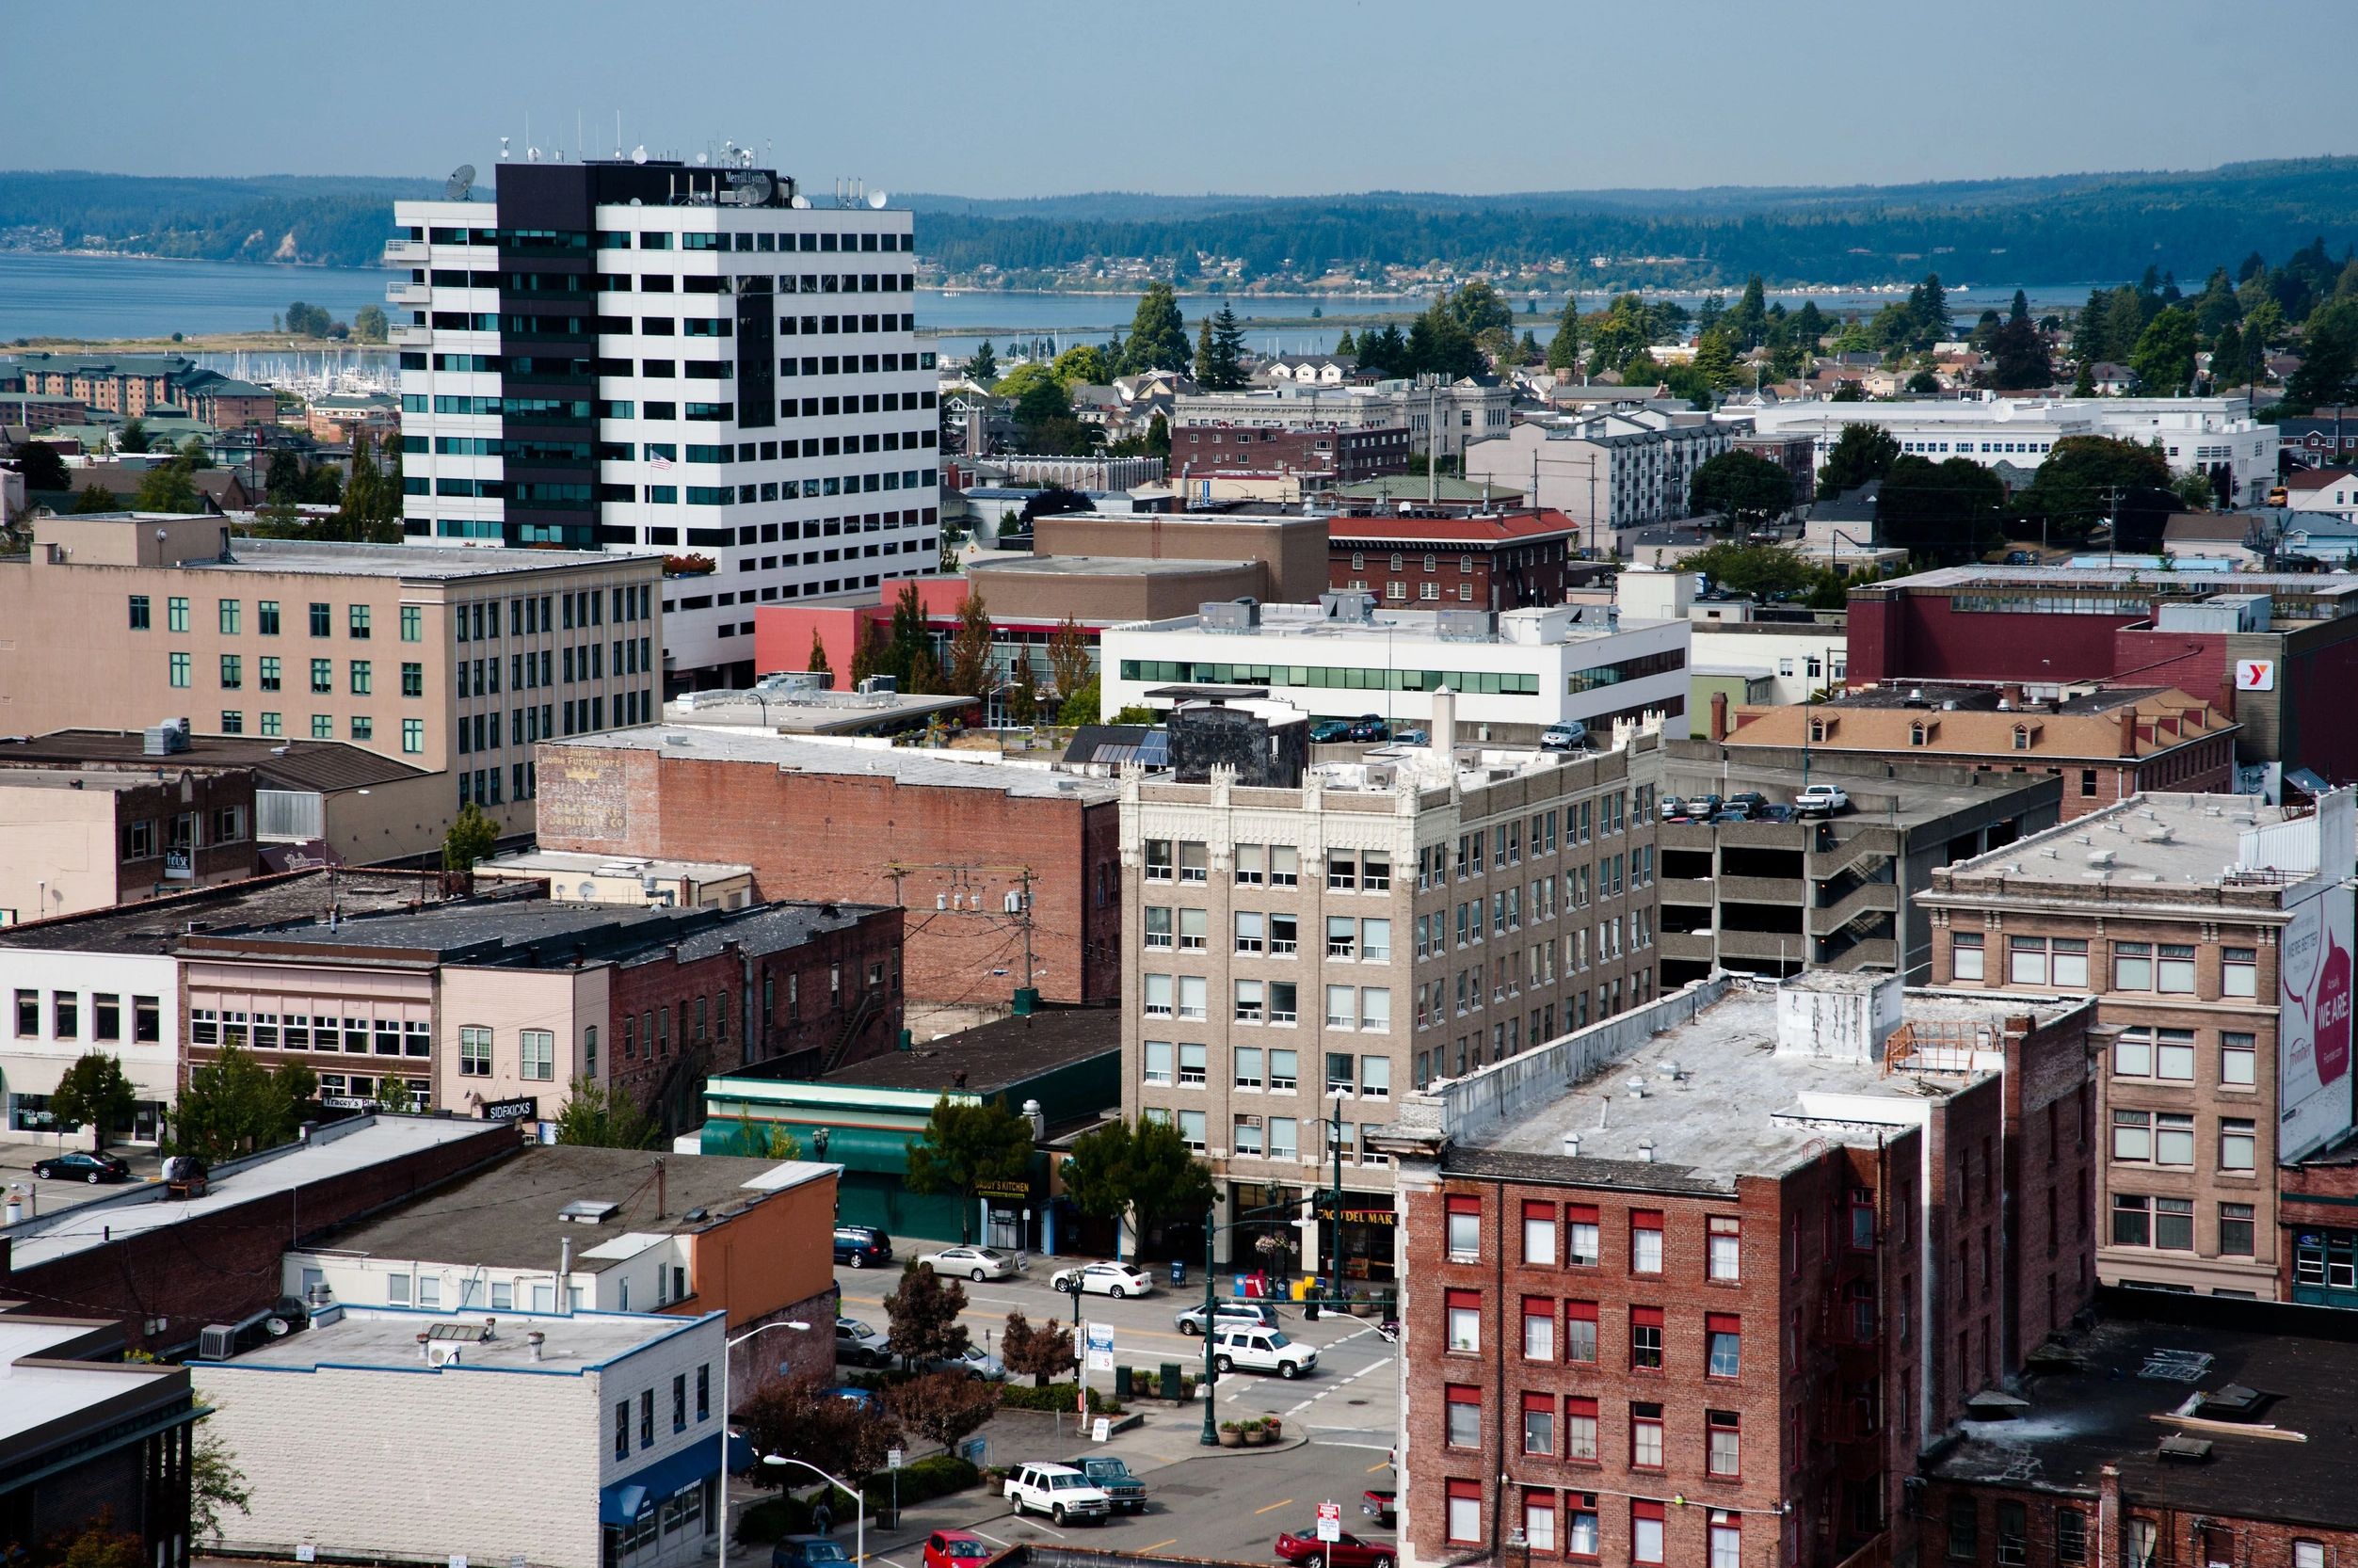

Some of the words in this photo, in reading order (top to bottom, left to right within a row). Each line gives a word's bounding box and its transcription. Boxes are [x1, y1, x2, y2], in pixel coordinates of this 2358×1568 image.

[726, 171, 747, 184] Merrill
[748, 171, 767, 186] Lynch
[542, 756, 565, 765] Home
[568, 757, 621, 768] Furnishers
[167, 852, 188, 867] HOUSE
[2318, 1000, 2331, 1032] WE
[2332, 991, 2349, 1024] ARE.
[326, 1096, 359, 1108] Tracey's
[489, 1101, 530, 1119] SIDEKICKS
[1002, 1181, 1029, 1192] KITCHEN
[1317, 1208, 1343, 1221] TAC
[1345, 1211, 1365, 1223] DEL
[1368, 1213, 1393, 1225] MAR
